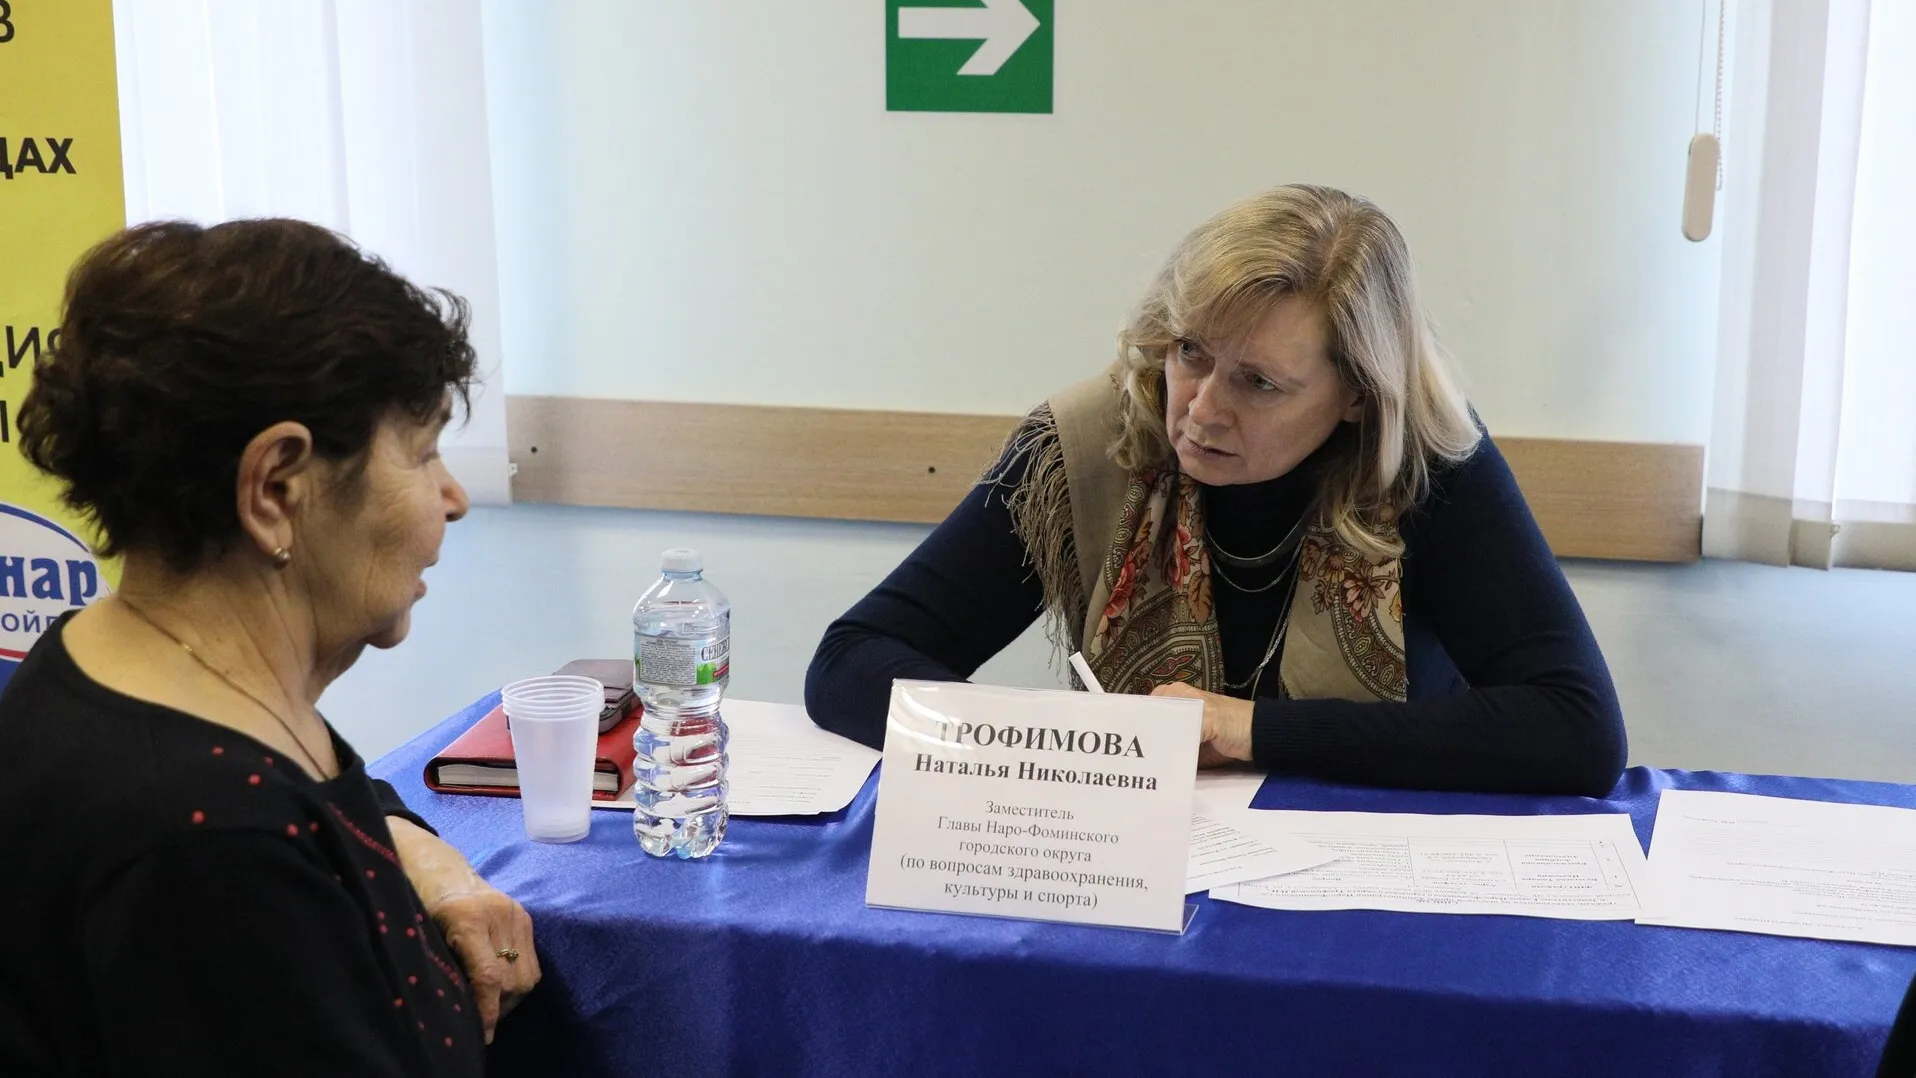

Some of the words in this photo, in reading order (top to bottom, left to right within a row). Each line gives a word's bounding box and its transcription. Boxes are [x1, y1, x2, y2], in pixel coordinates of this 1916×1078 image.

[935, 720, 1145, 758] ТРОФИМОВА
[914, 754, 1010, 778] Наталья
[1017, 762, 1158, 791] Николаевна
[986, 801, 1074, 819] Заместитель
[938, 816, 981, 832] Главы
[987, 821, 1118, 844] Наро-Фоминского
[960, 842, 1038, 857] городского
[1043, 849, 1091, 864] округа
[901, 854, 924, 869] (по
[930, 860, 1002, 876] вопросам
[1008, 867, 1147, 890] здравоохранения,
[945, 884, 1018, 902] культуры
[1024, 891, 1032, 901] и
[1038, 892, 1097, 910] спорта)
